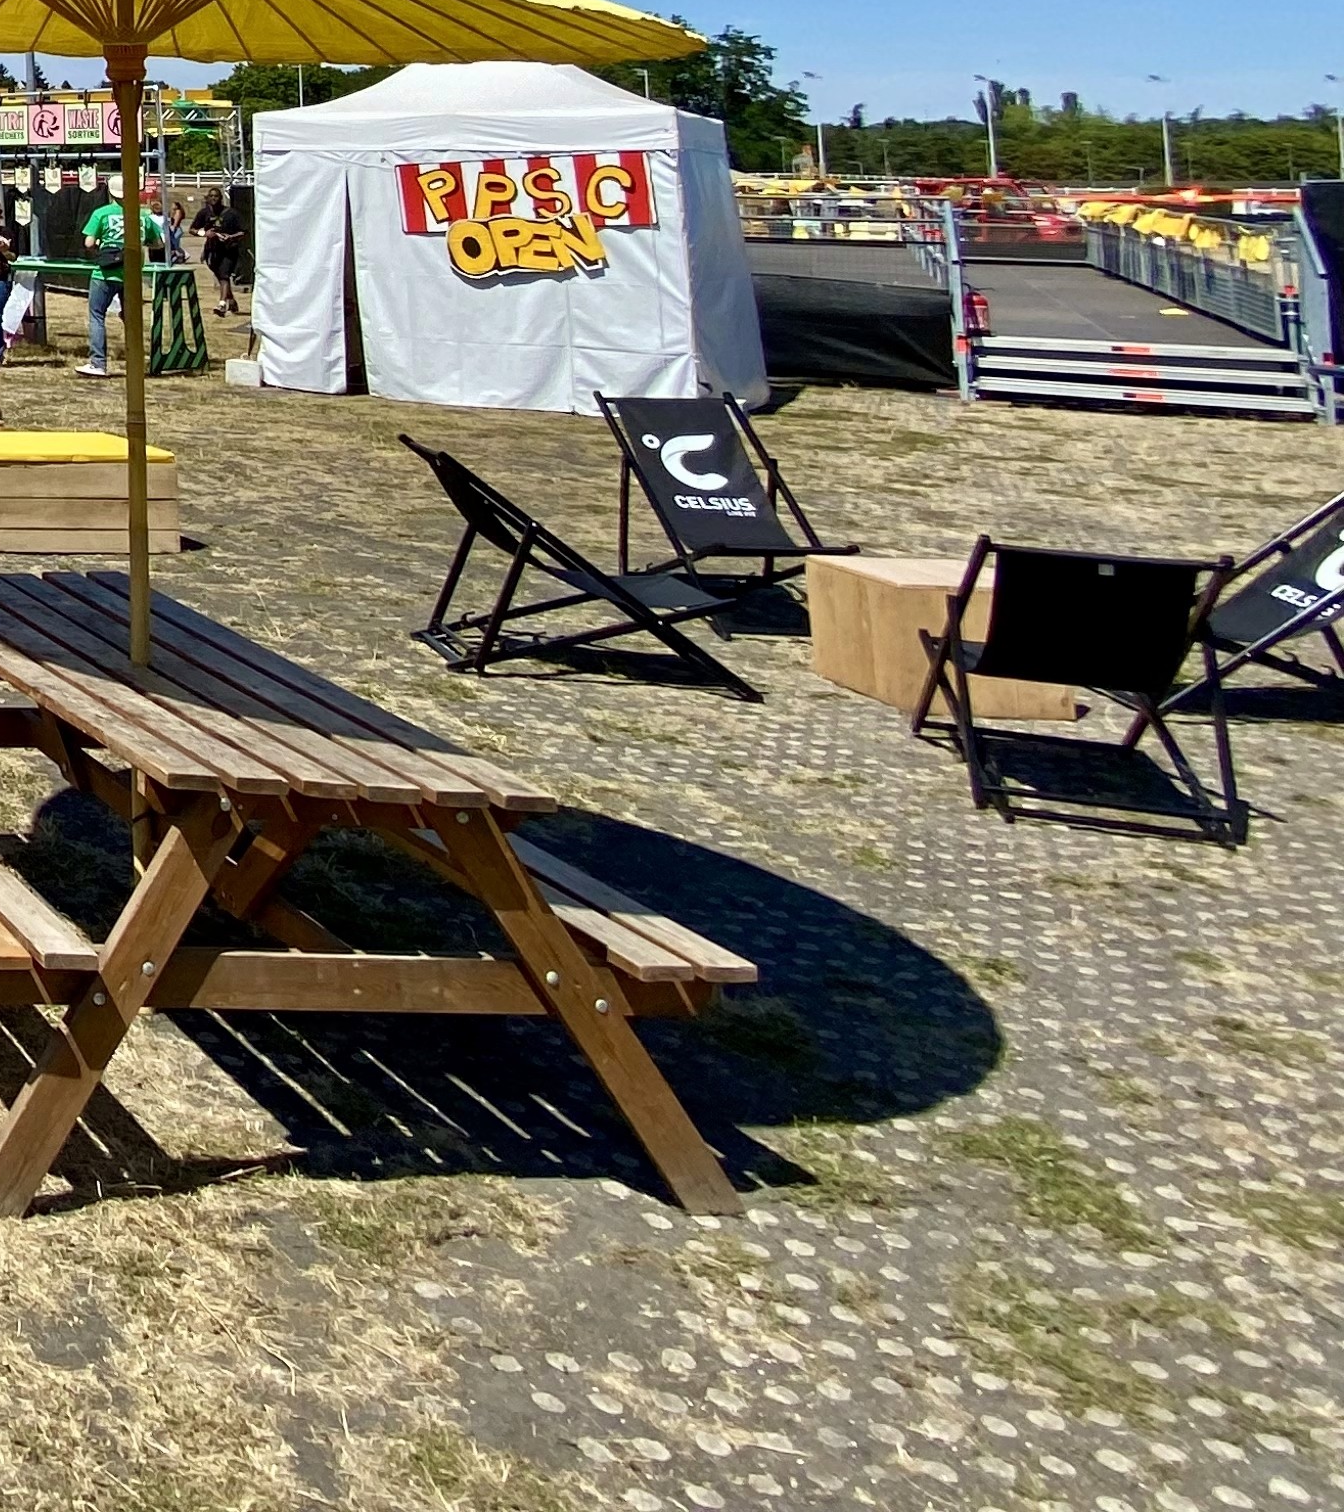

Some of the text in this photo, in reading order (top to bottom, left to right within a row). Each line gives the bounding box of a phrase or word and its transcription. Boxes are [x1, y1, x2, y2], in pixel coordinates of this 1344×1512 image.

[67, 108, 99, 130] WASTE
[67, 129, 100, 139] SORTING
[447, 214, 606, 276] OPEN
